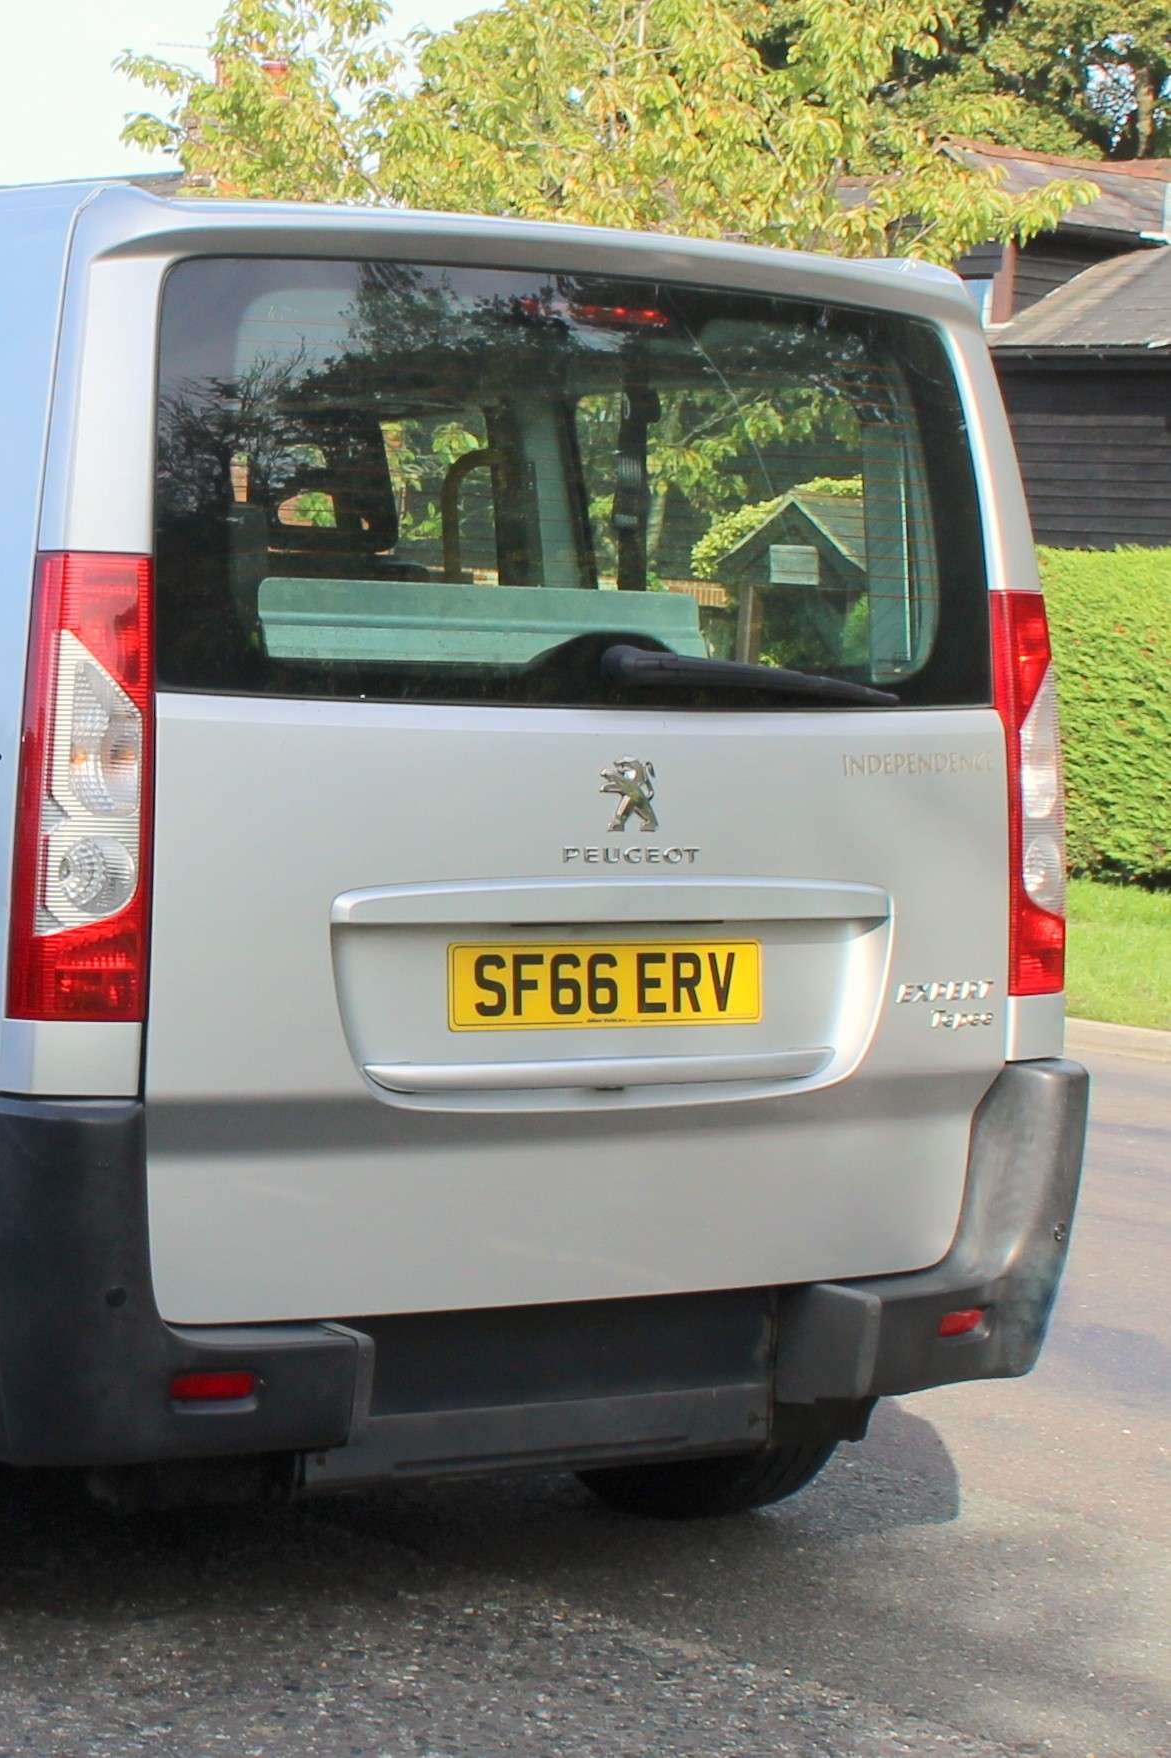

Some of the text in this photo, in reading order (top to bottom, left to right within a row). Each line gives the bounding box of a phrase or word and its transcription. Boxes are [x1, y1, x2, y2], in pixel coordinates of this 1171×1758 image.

[842, 751, 997, 777] INDEPENDENCE
[562, 846, 701, 864] PEUGEOT
[474, 952, 736, 1017] SF66 ERV
[894, 980, 995, 1004] EXPERT
